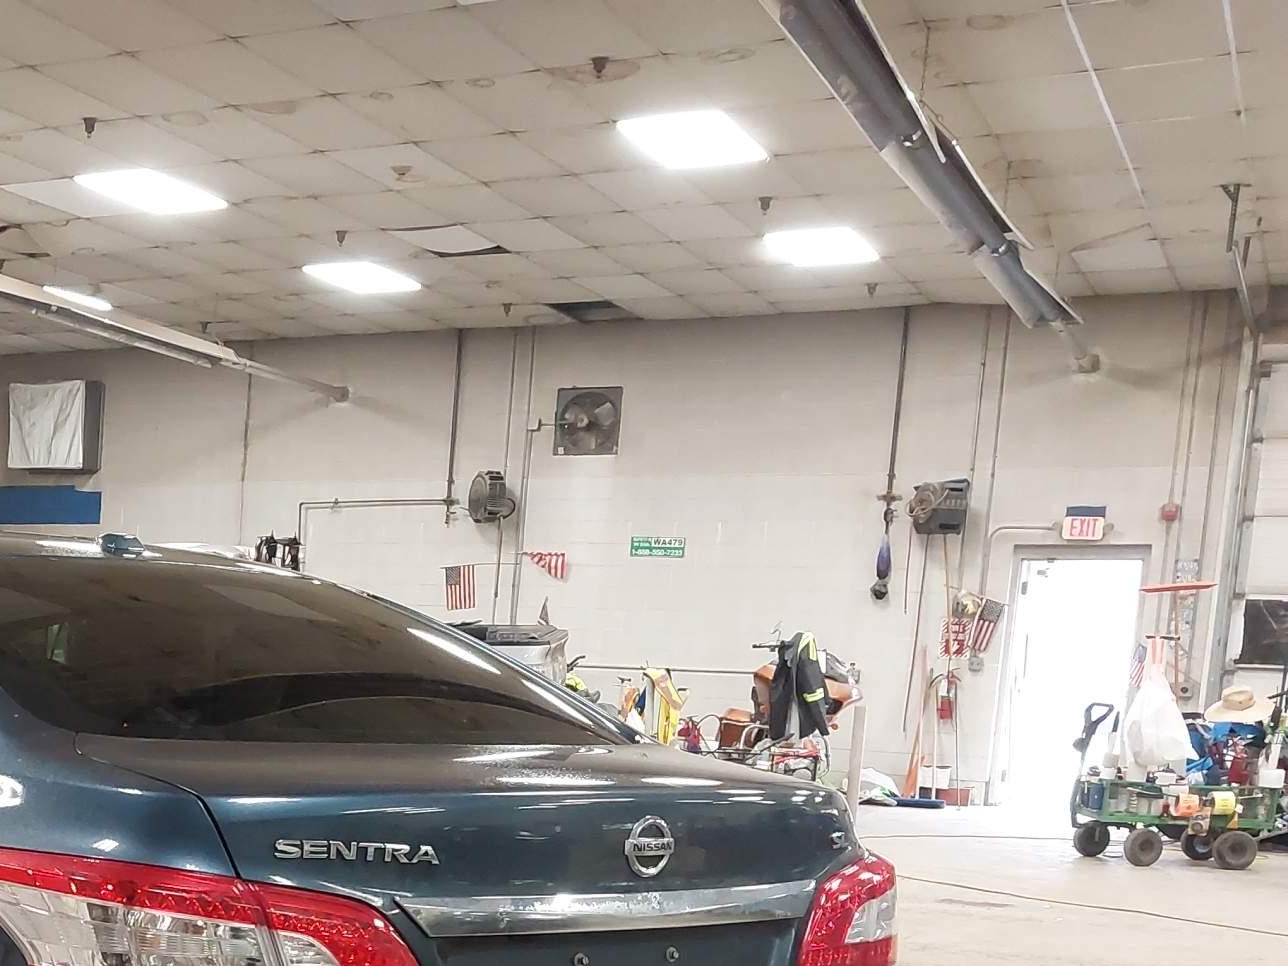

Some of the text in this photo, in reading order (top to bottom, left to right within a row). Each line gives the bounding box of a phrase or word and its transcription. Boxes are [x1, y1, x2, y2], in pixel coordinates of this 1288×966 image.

[1069, 518, 1098, 537] EXIT
[653, 538, 683, 546] WA479
[274, 839, 440, 865] SENTRA
[632, 842, 672, 852] NISSAN
